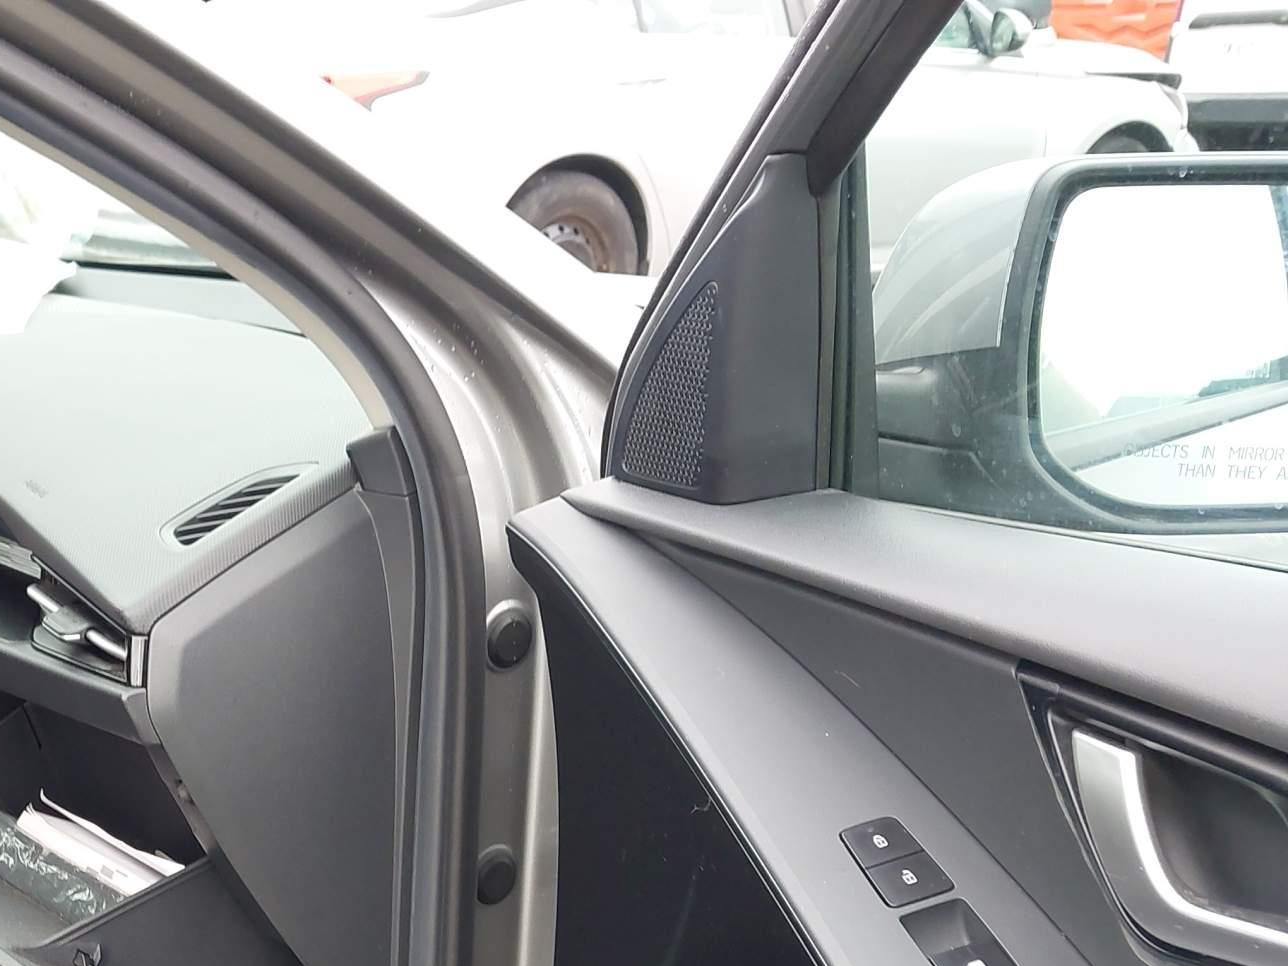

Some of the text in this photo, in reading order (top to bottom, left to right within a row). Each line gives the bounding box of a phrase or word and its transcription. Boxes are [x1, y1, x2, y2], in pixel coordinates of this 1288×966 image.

[1201, 445, 1216, 460] IN
[1177, 463, 1216, 478] THAN
[1228, 464, 1268, 480] THEY
